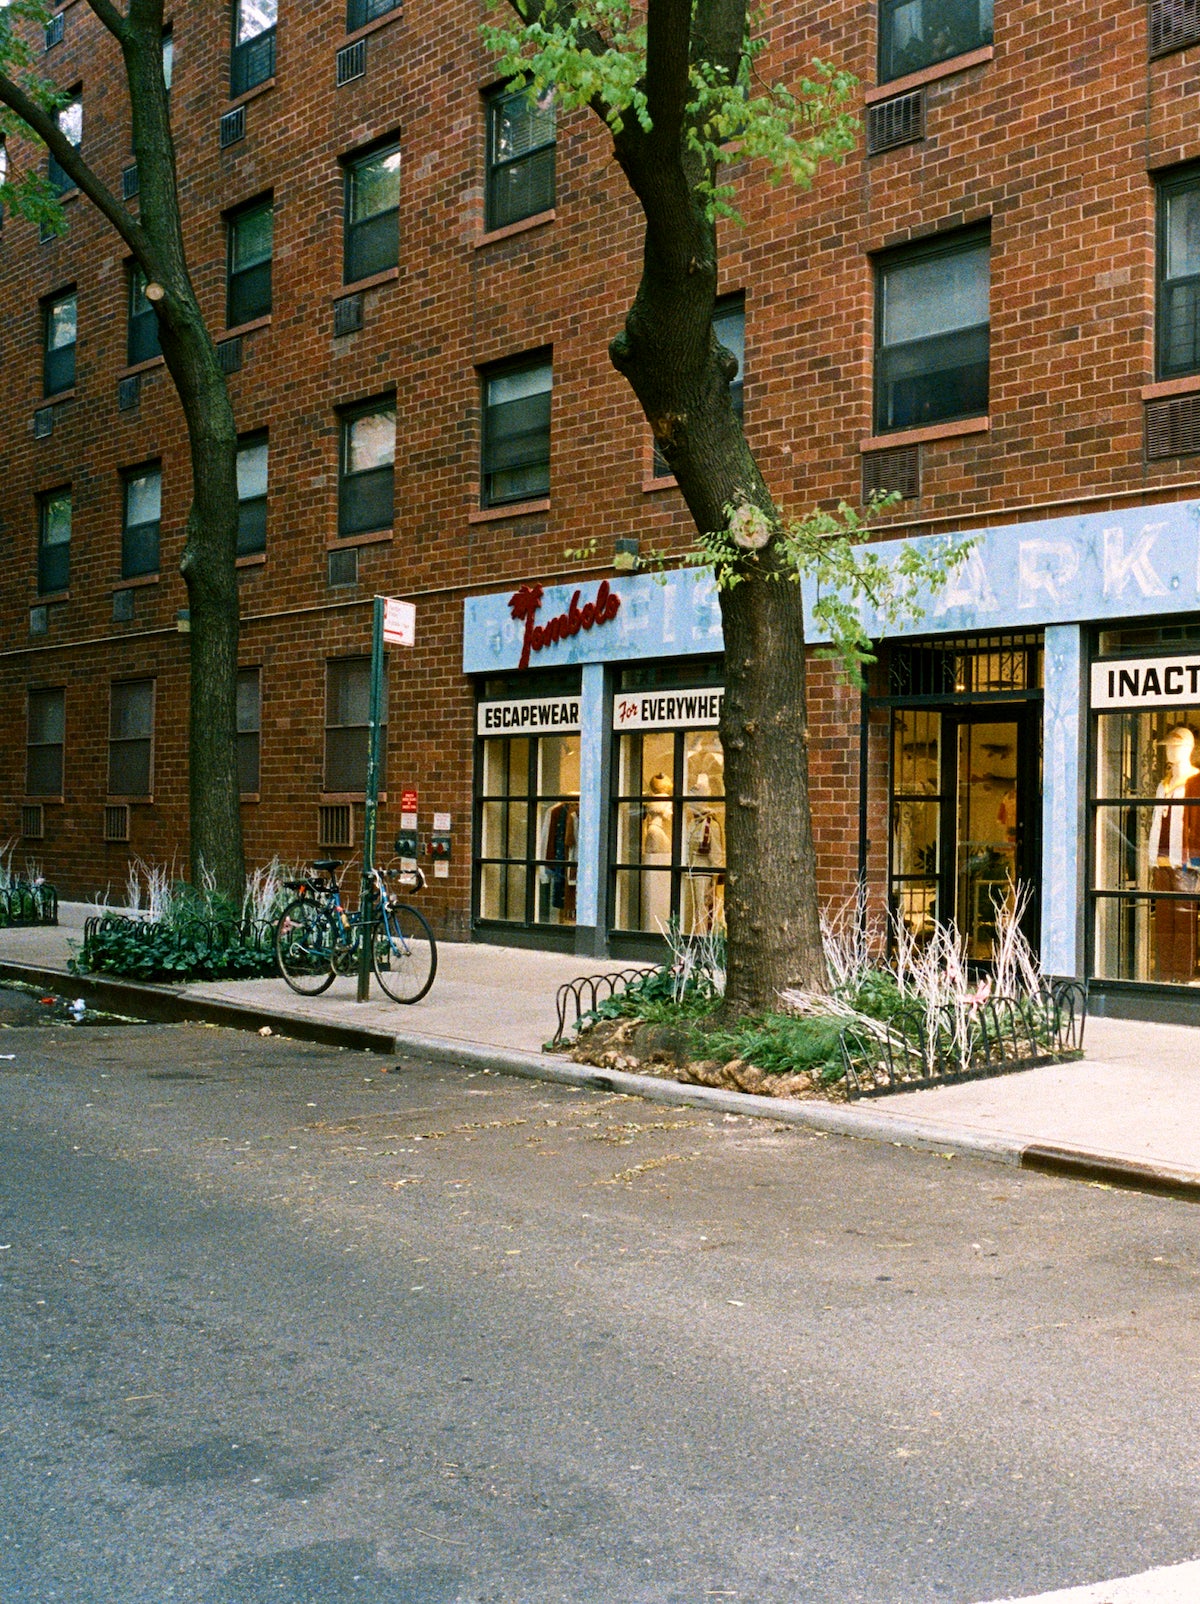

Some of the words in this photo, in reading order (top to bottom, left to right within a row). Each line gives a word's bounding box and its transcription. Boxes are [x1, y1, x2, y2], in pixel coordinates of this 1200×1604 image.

[508, 580, 621, 671] Tombolo
[485, 702, 579, 728] ESCAPEWEAR
[619, 700, 638, 724] For
